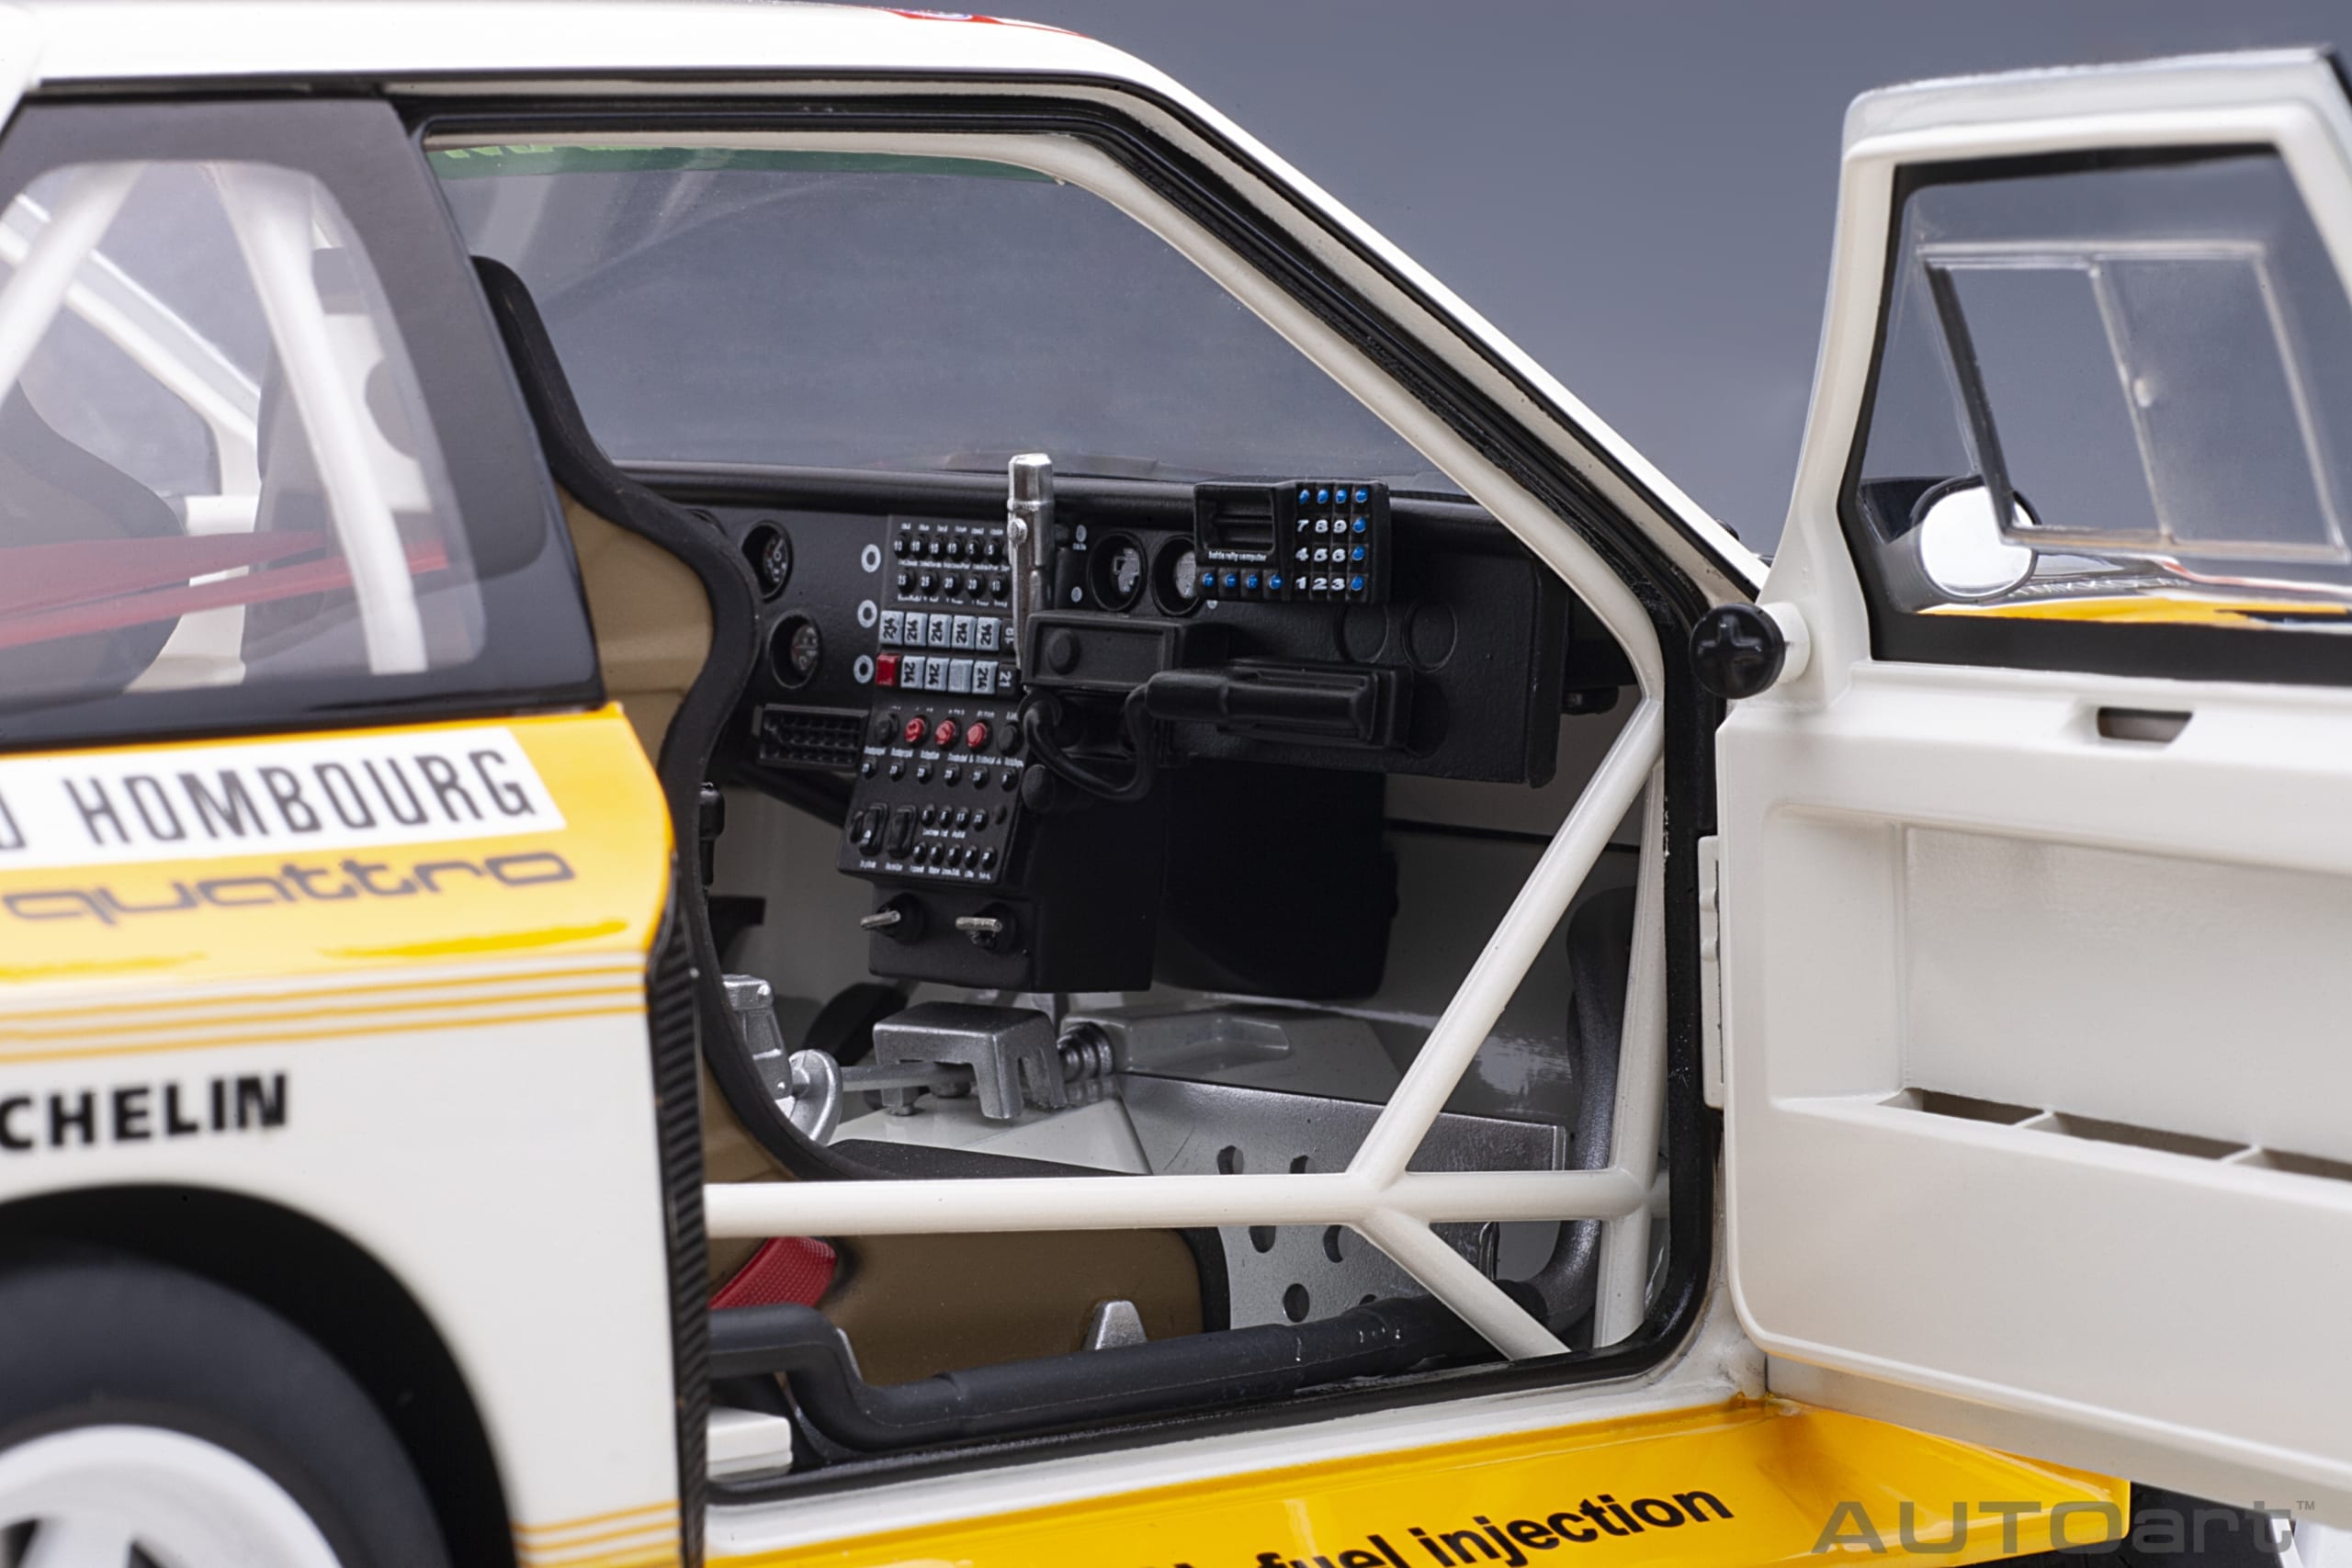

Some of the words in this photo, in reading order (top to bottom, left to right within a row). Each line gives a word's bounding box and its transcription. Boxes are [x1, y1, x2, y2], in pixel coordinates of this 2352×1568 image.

[1297, 519, 1309, 532] 7
[1315, 519, 1329, 533] 8
[1333, 519, 1347, 533] 9
[1295, 547, 1309, 561] 4
[1332, 548, 1346, 562] 6
[1295, 576, 1306, 590] 1
[1312, 577, 1328, 591] 2
[1331, 577, 1345, 591] 3
[62, 749, 537, 846] HOMBOURG
[2, 851, 576, 926] quattro
[1408, 1490, 1735, 1568] injection
